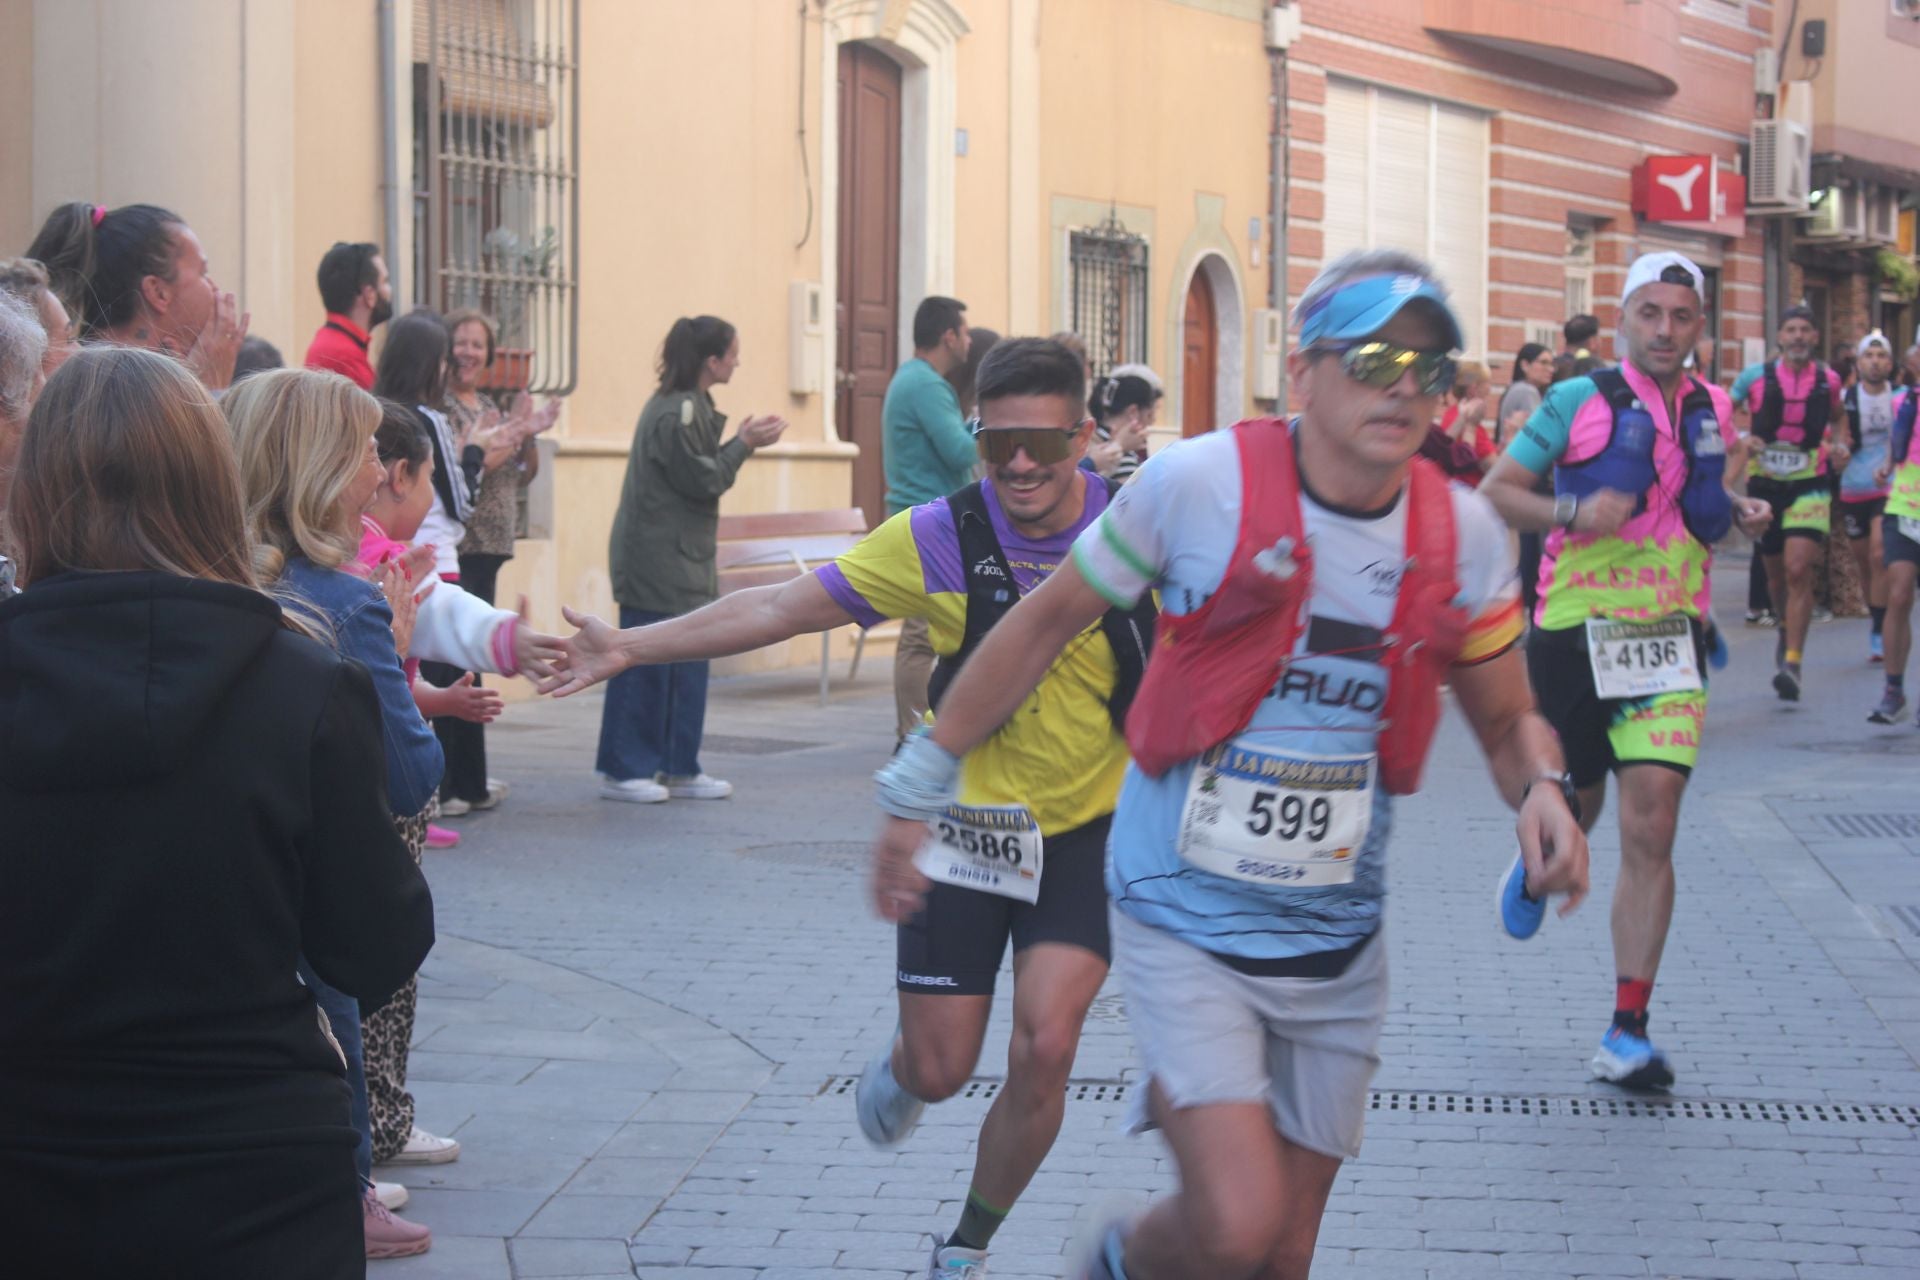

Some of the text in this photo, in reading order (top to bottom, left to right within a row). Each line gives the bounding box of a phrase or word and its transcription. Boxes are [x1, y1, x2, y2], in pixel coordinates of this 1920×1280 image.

[1616, 640, 1679, 670] 4136
[1246, 791, 1330, 842] 599
[938, 822, 1022, 865] 2586
[899, 971, 958, 986] LURBEL
